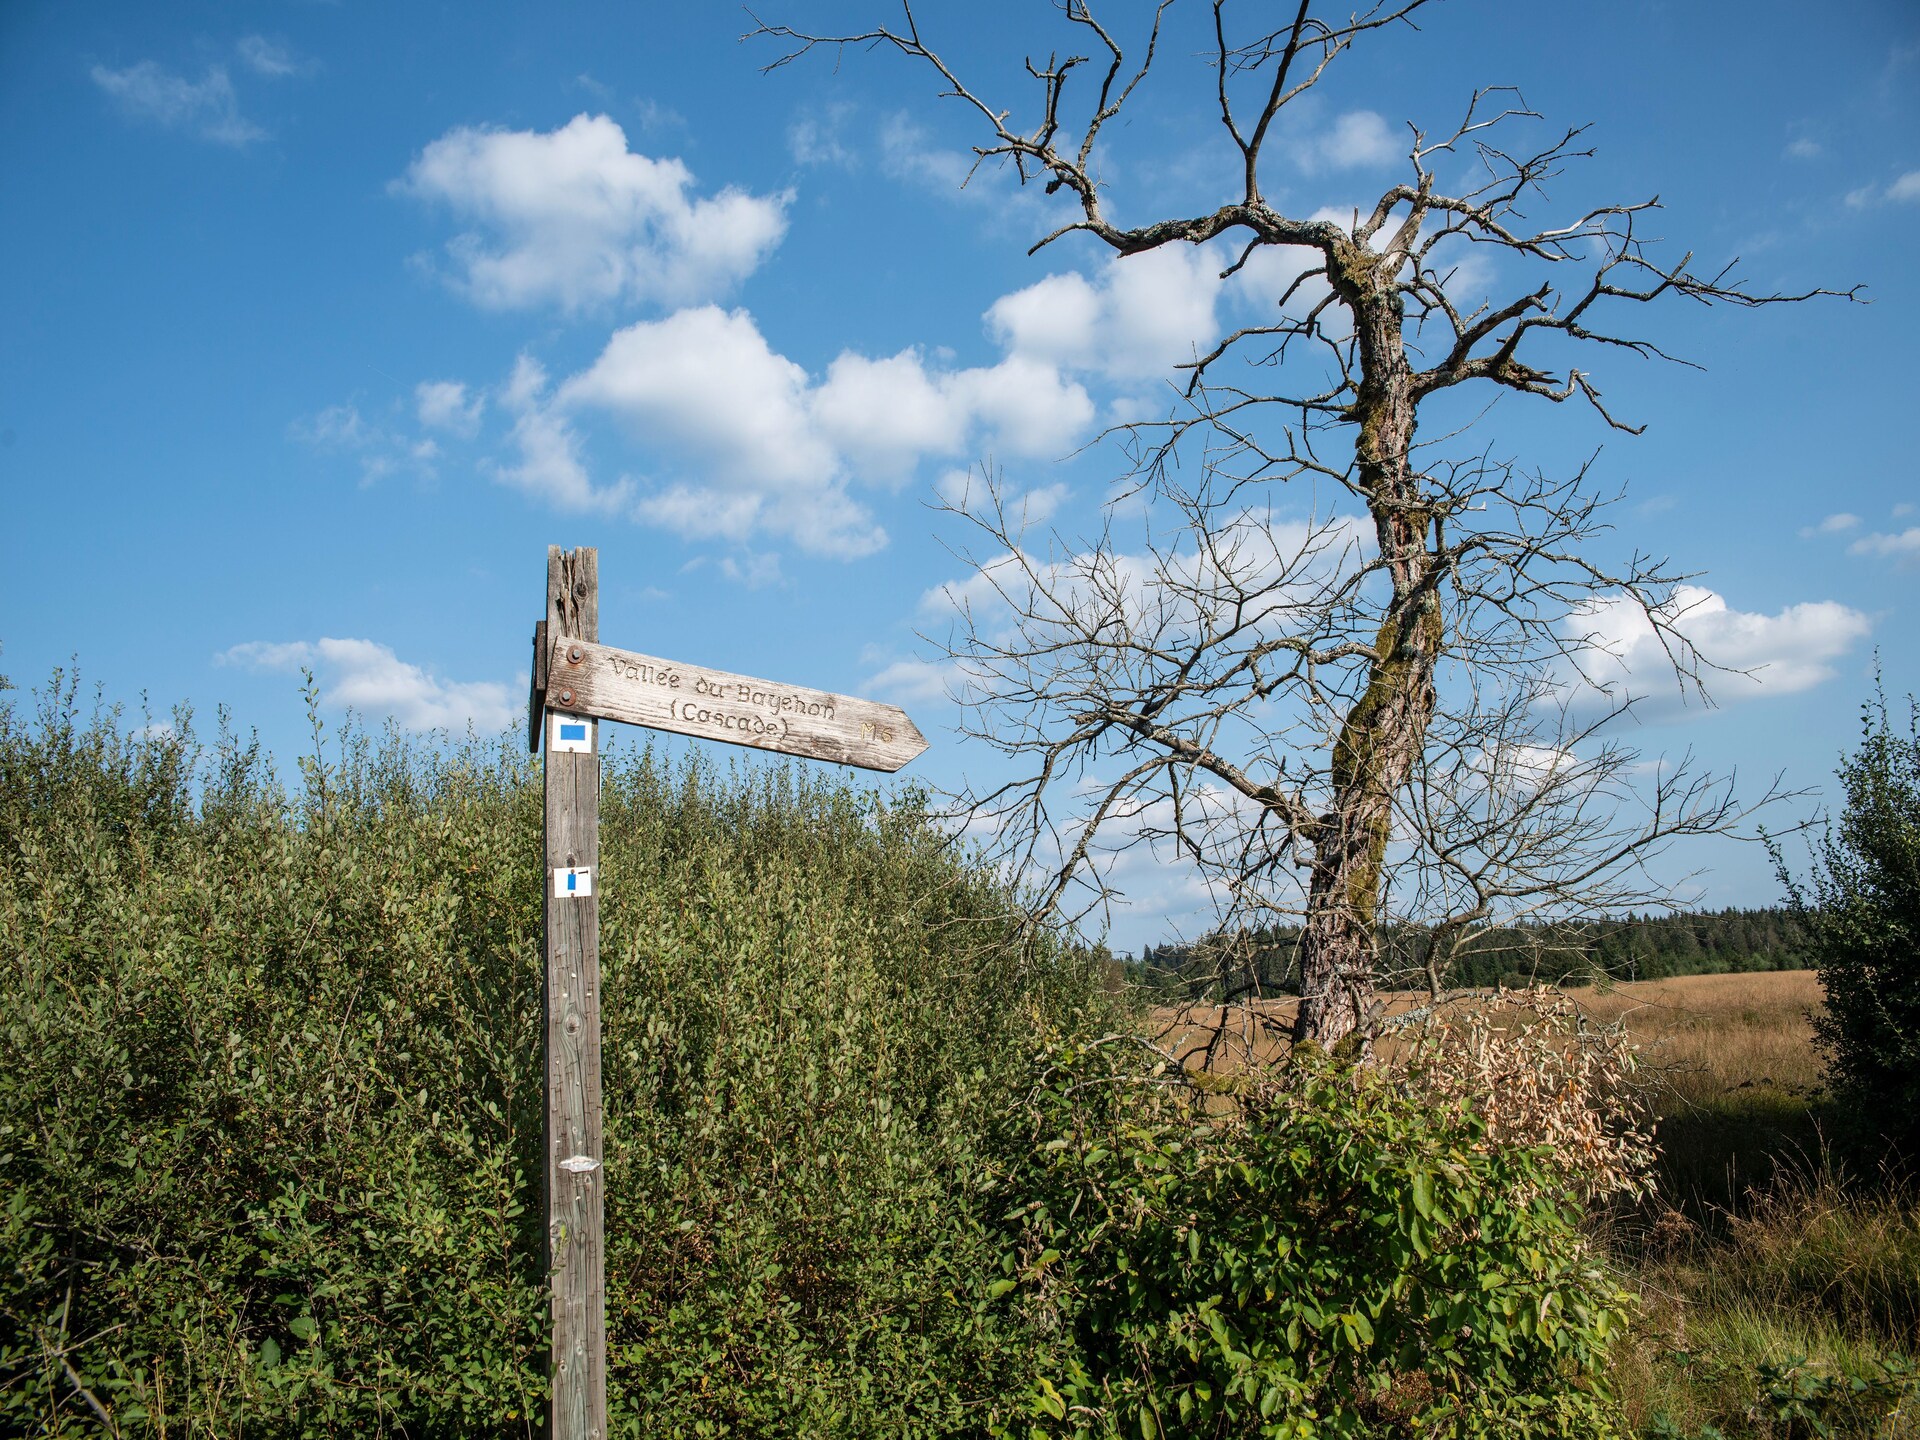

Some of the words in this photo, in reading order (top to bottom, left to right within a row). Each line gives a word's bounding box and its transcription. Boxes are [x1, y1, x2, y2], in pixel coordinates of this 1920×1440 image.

[607, 656, 681, 689] Vallée
[694, 675, 725, 698] du
[736, 683, 836, 721] Bayehon
[670, 697, 789, 742] (Cascade)
